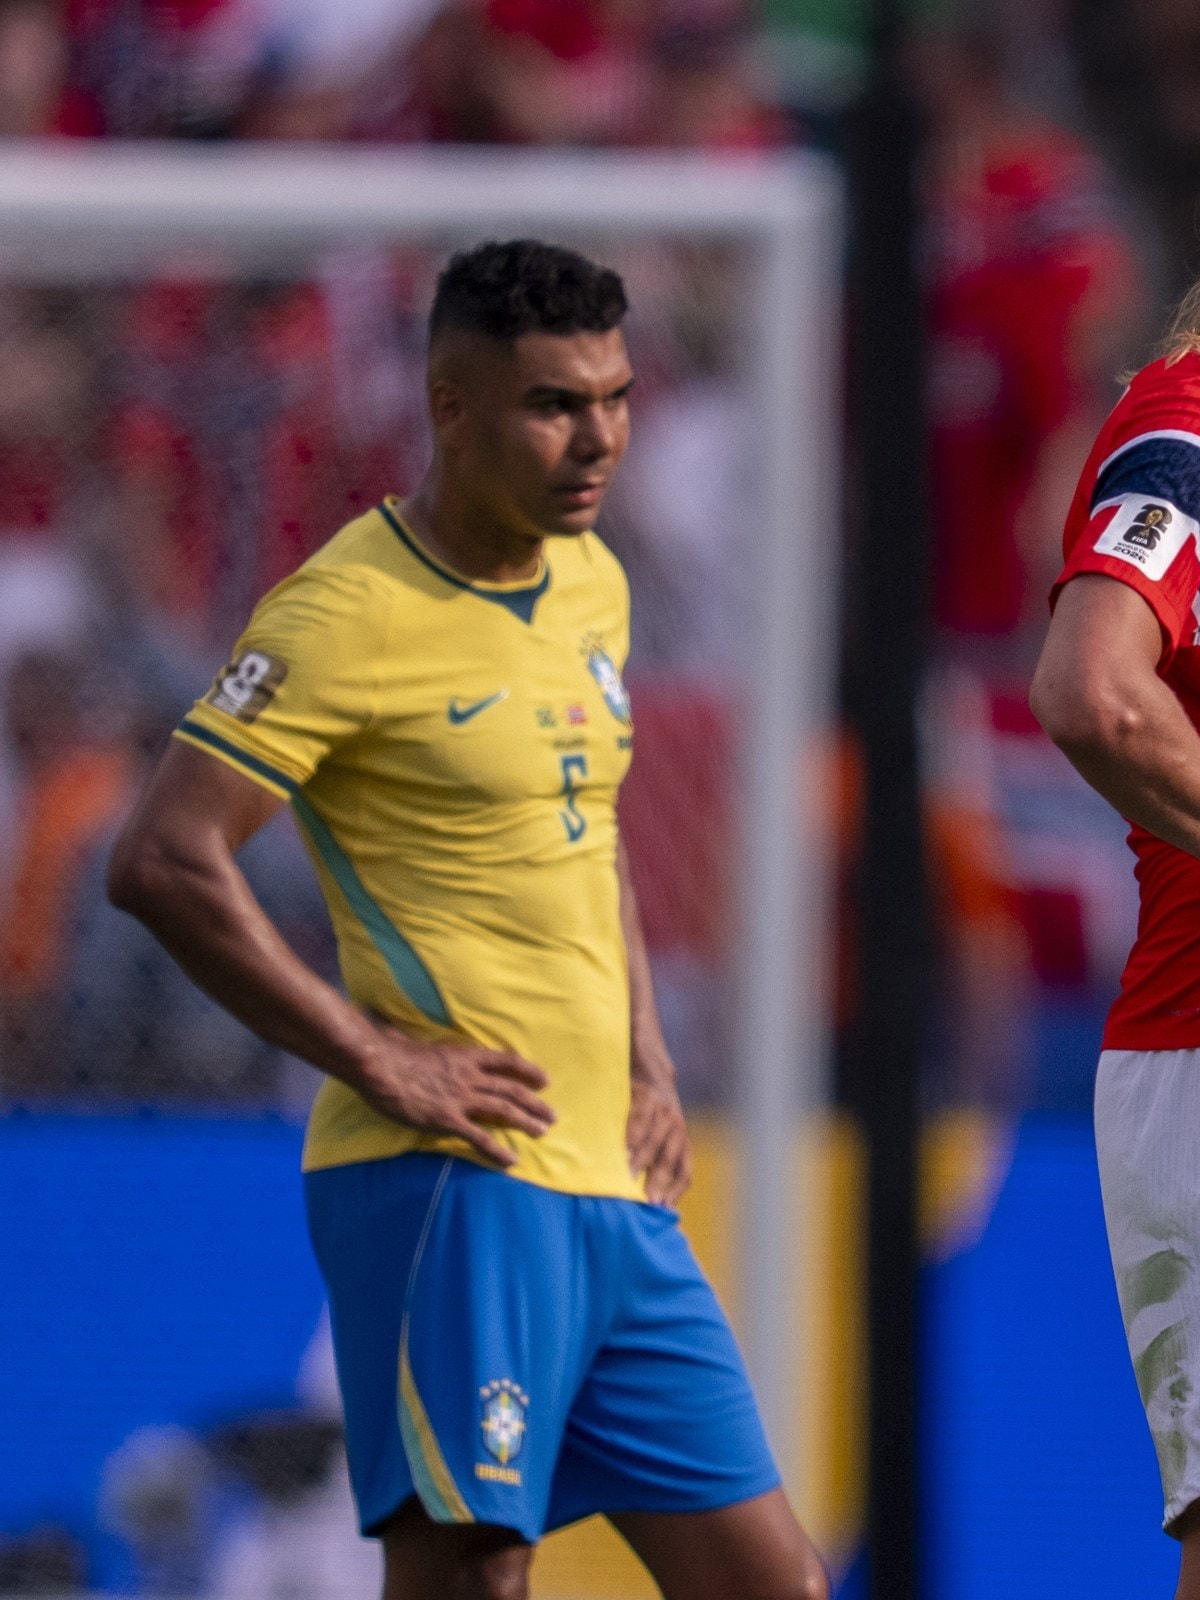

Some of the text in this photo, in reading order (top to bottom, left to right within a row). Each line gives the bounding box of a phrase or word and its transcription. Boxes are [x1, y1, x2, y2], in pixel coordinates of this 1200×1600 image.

[1131, 536, 1148, 545] FIFA
[1112, 545, 1146, 564] 2026
[560, 755, 588, 843] 5
